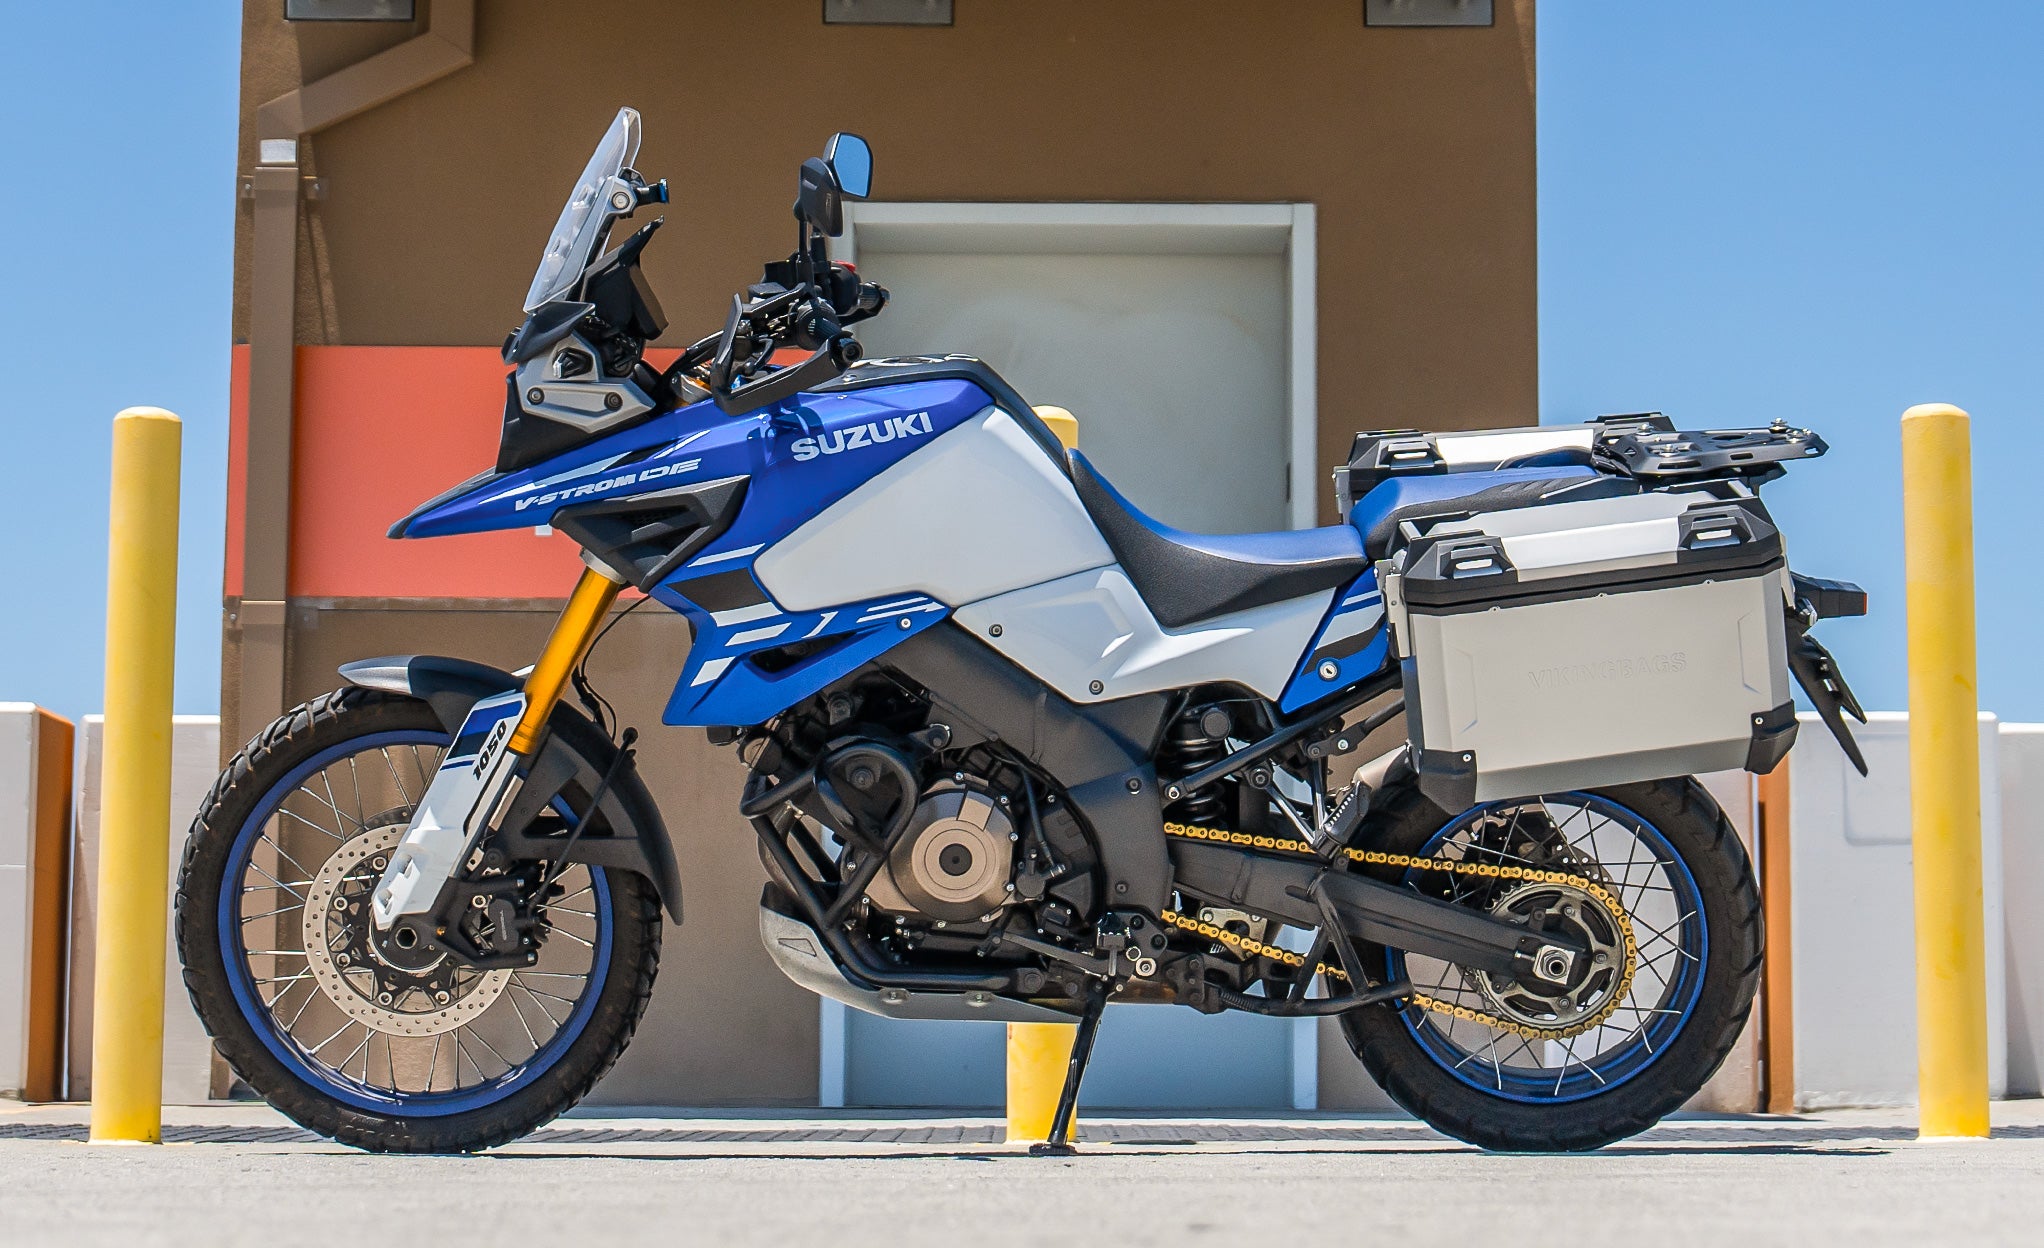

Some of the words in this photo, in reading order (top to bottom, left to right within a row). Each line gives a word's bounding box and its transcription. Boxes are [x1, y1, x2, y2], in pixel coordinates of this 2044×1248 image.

[791, 411, 934, 461] SUZUKI
[515, 475, 636, 510] V-STROM
[639, 458, 702, 481] DE
[473, 721, 506, 780] 1050
